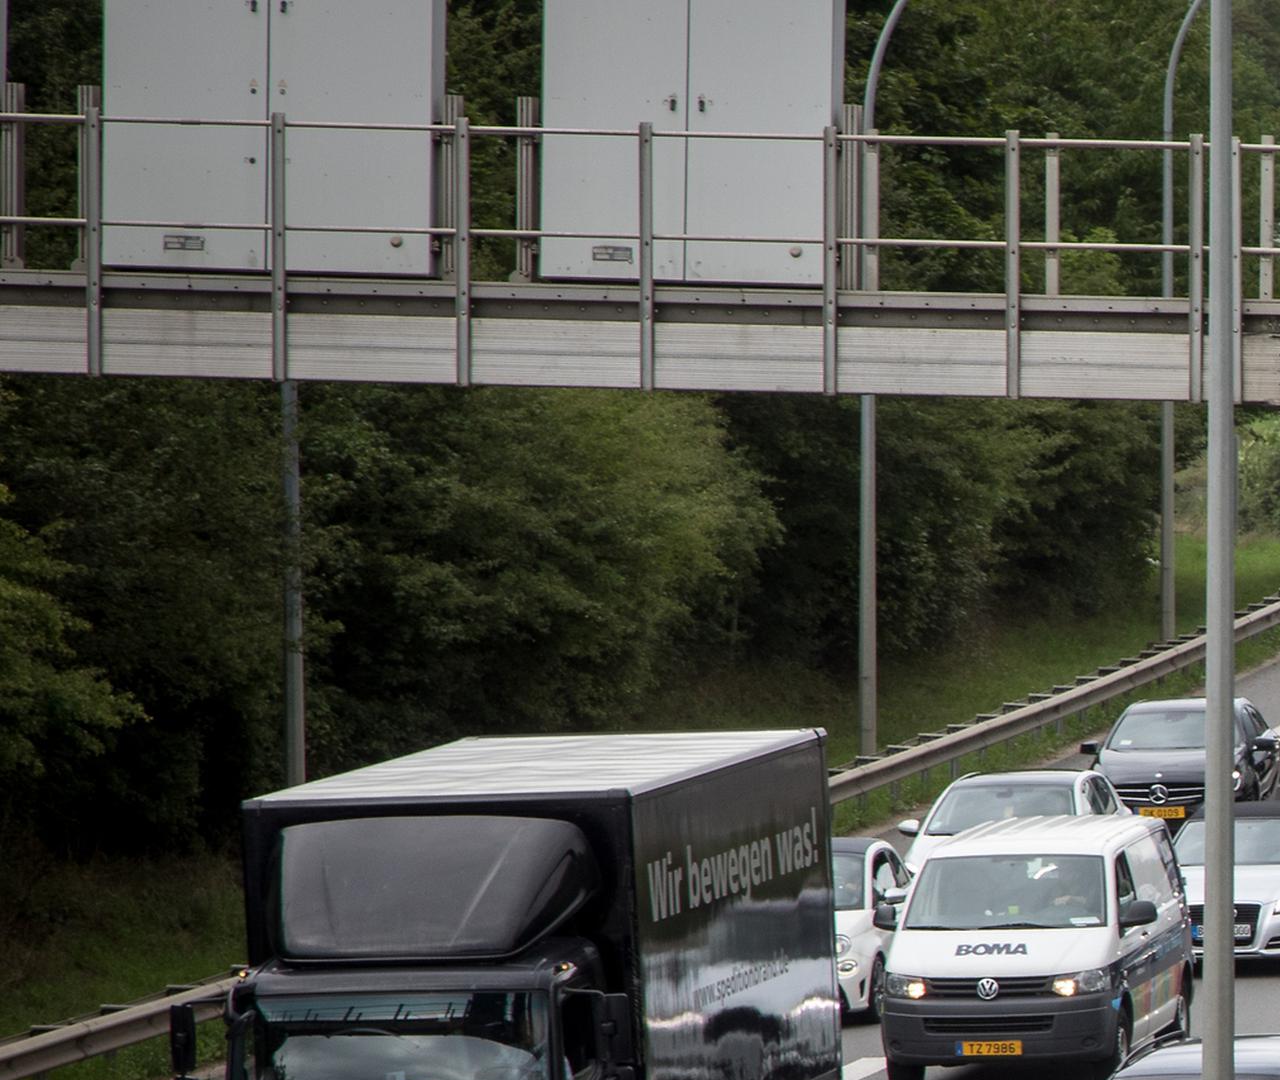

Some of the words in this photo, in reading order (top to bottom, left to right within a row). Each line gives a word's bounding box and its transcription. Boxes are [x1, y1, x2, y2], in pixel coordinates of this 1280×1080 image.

[647, 851, 683, 922] Wir
[686, 836, 773, 909] bewegen
[775, 806, 819, 876] was!
[954, 943, 1028, 956] BOMA
[968, 1043, 983, 1054] TZ
[985, 1043, 1016, 1053] 7986
